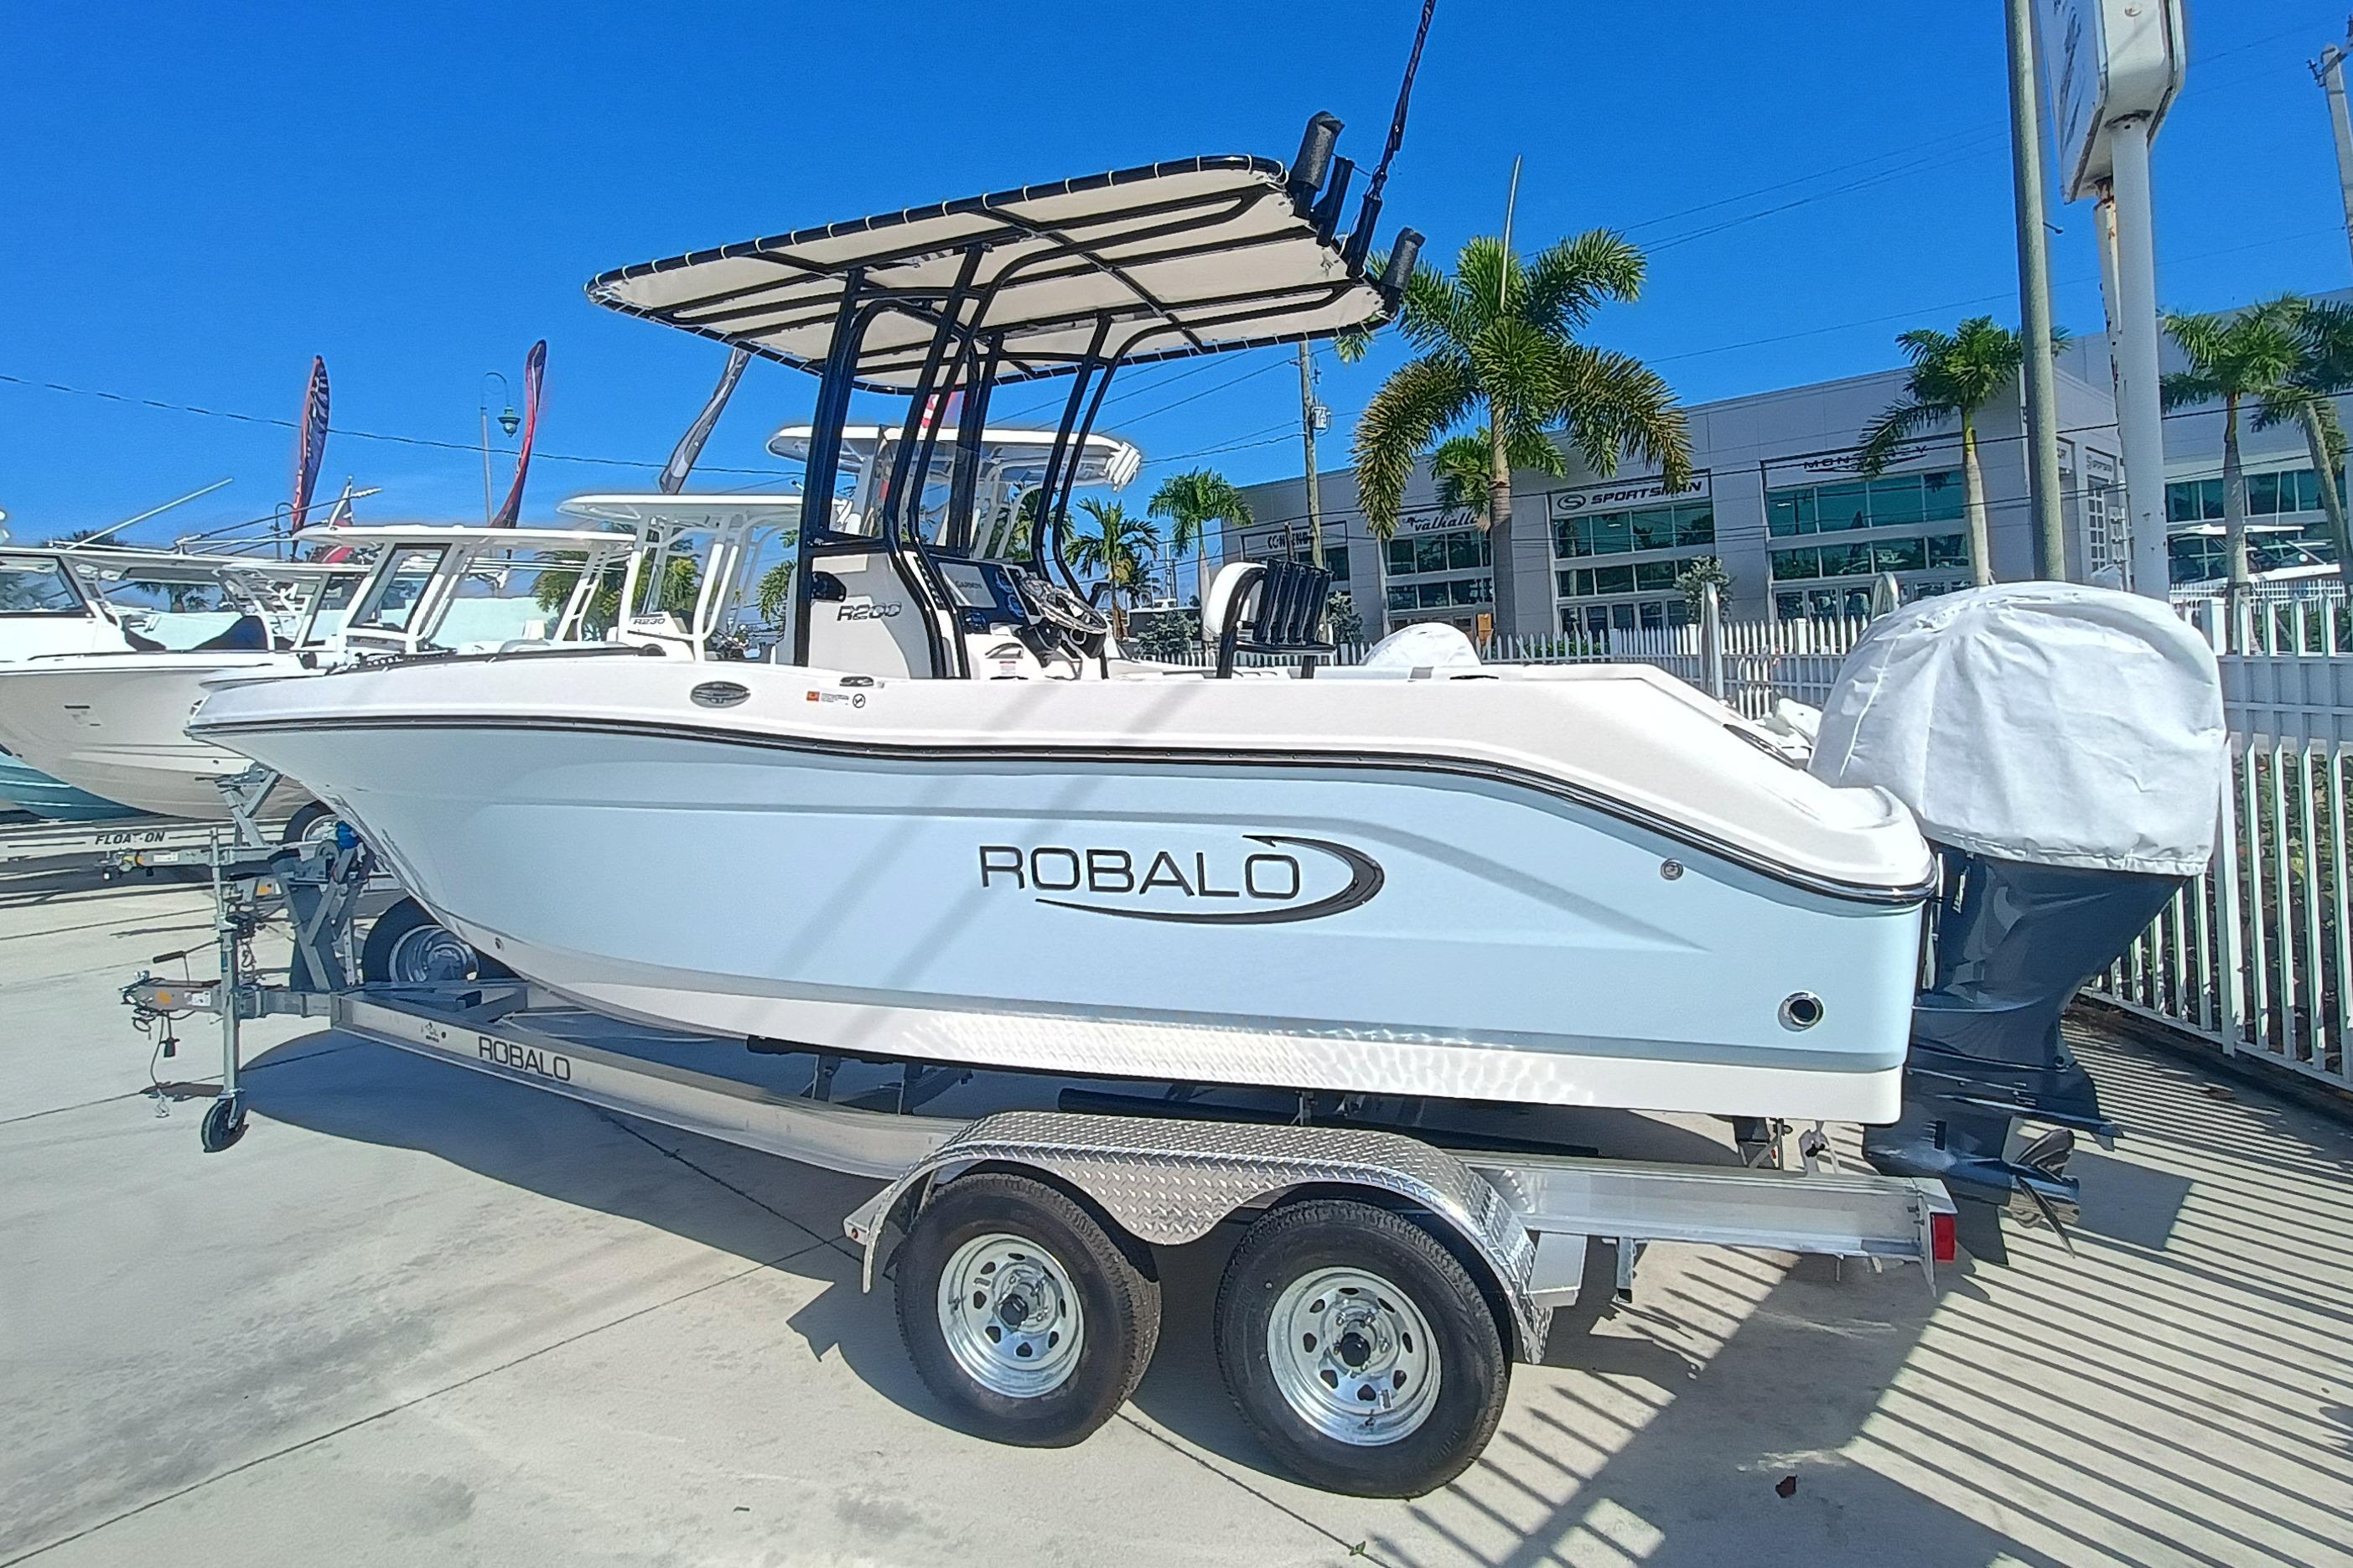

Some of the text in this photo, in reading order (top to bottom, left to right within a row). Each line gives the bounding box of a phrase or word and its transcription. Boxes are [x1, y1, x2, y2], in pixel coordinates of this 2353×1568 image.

[1803, 445, 1927, 469] MONEY
[836, 602, 902, 622] R200
[979, 845, 1300, 899] ROBALO
[478, 1035, 572, 1082] ROBALO
